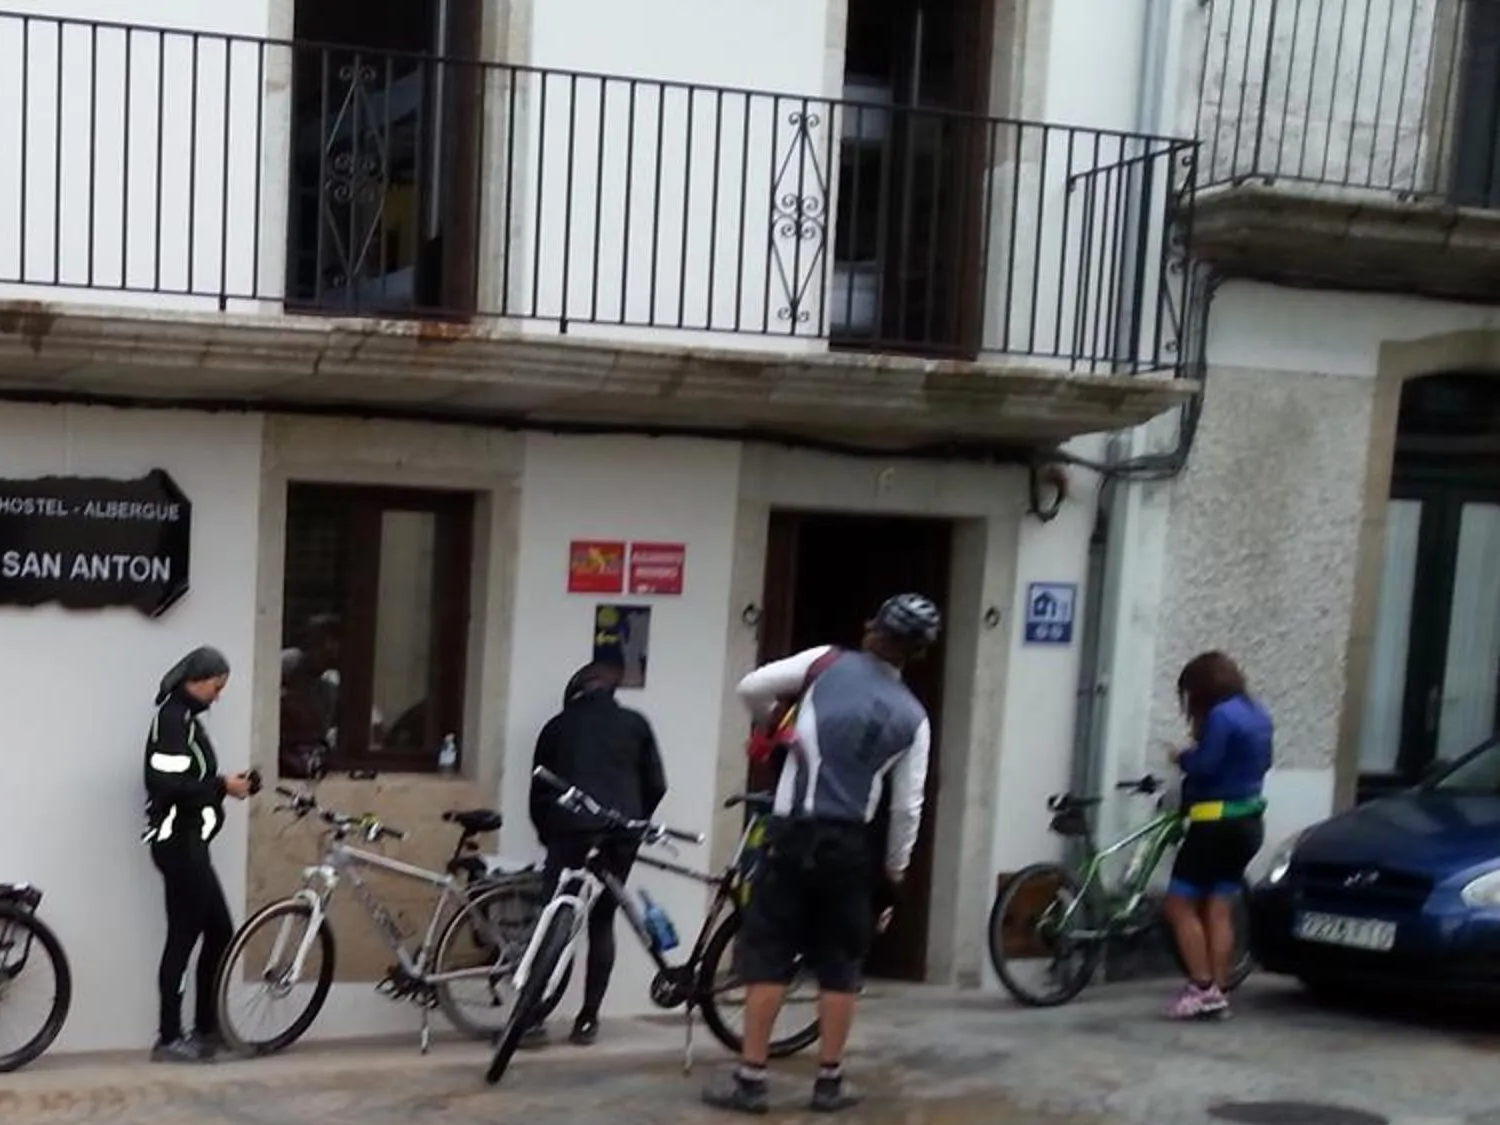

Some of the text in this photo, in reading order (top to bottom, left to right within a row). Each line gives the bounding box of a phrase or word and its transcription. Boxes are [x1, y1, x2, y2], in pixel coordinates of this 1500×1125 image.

[84, 500, 180, 522] ALBERGUE
[2, 551, 171, 583] SAN ANTON
